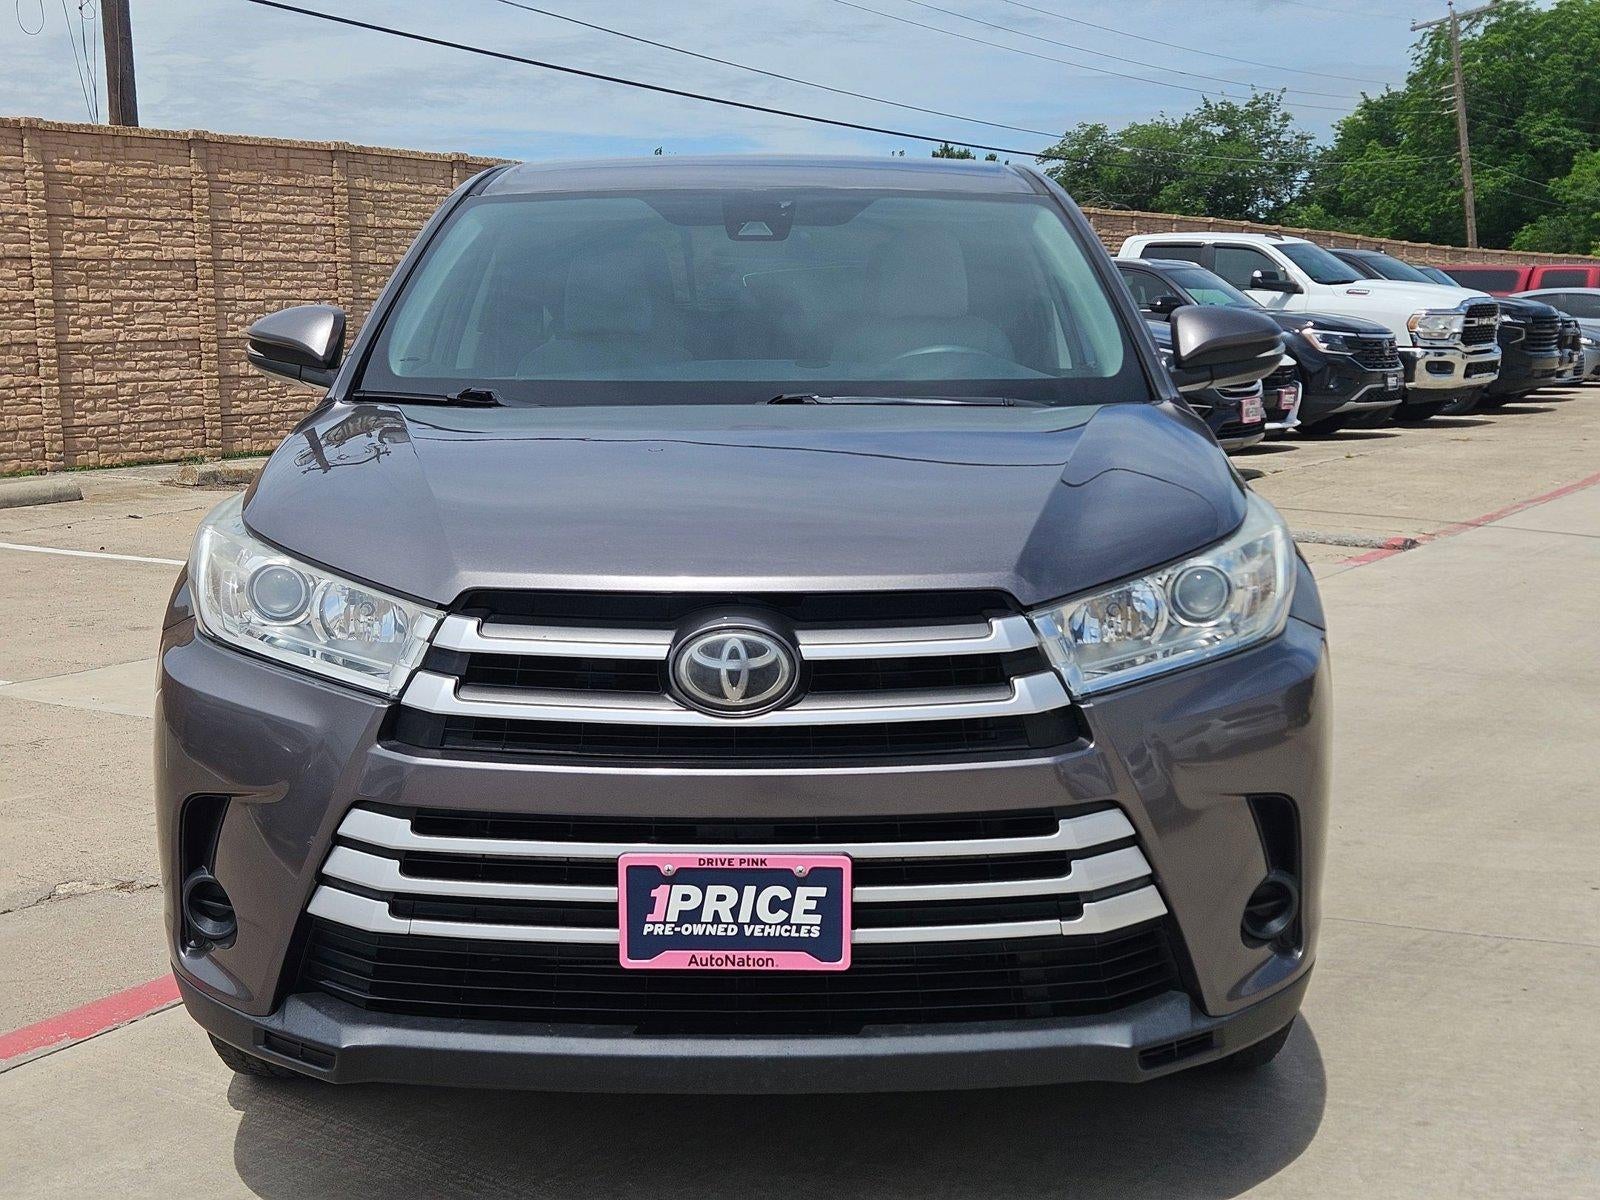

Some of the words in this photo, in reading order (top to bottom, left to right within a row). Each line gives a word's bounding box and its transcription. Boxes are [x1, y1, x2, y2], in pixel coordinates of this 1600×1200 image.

[698, 858, 735, 867] DRIVE
[739, 858, 768, 867] PINK
[643, 923, 739, 937] PRE-OWNED
[743, 925, 821, 938] VEHICLES
